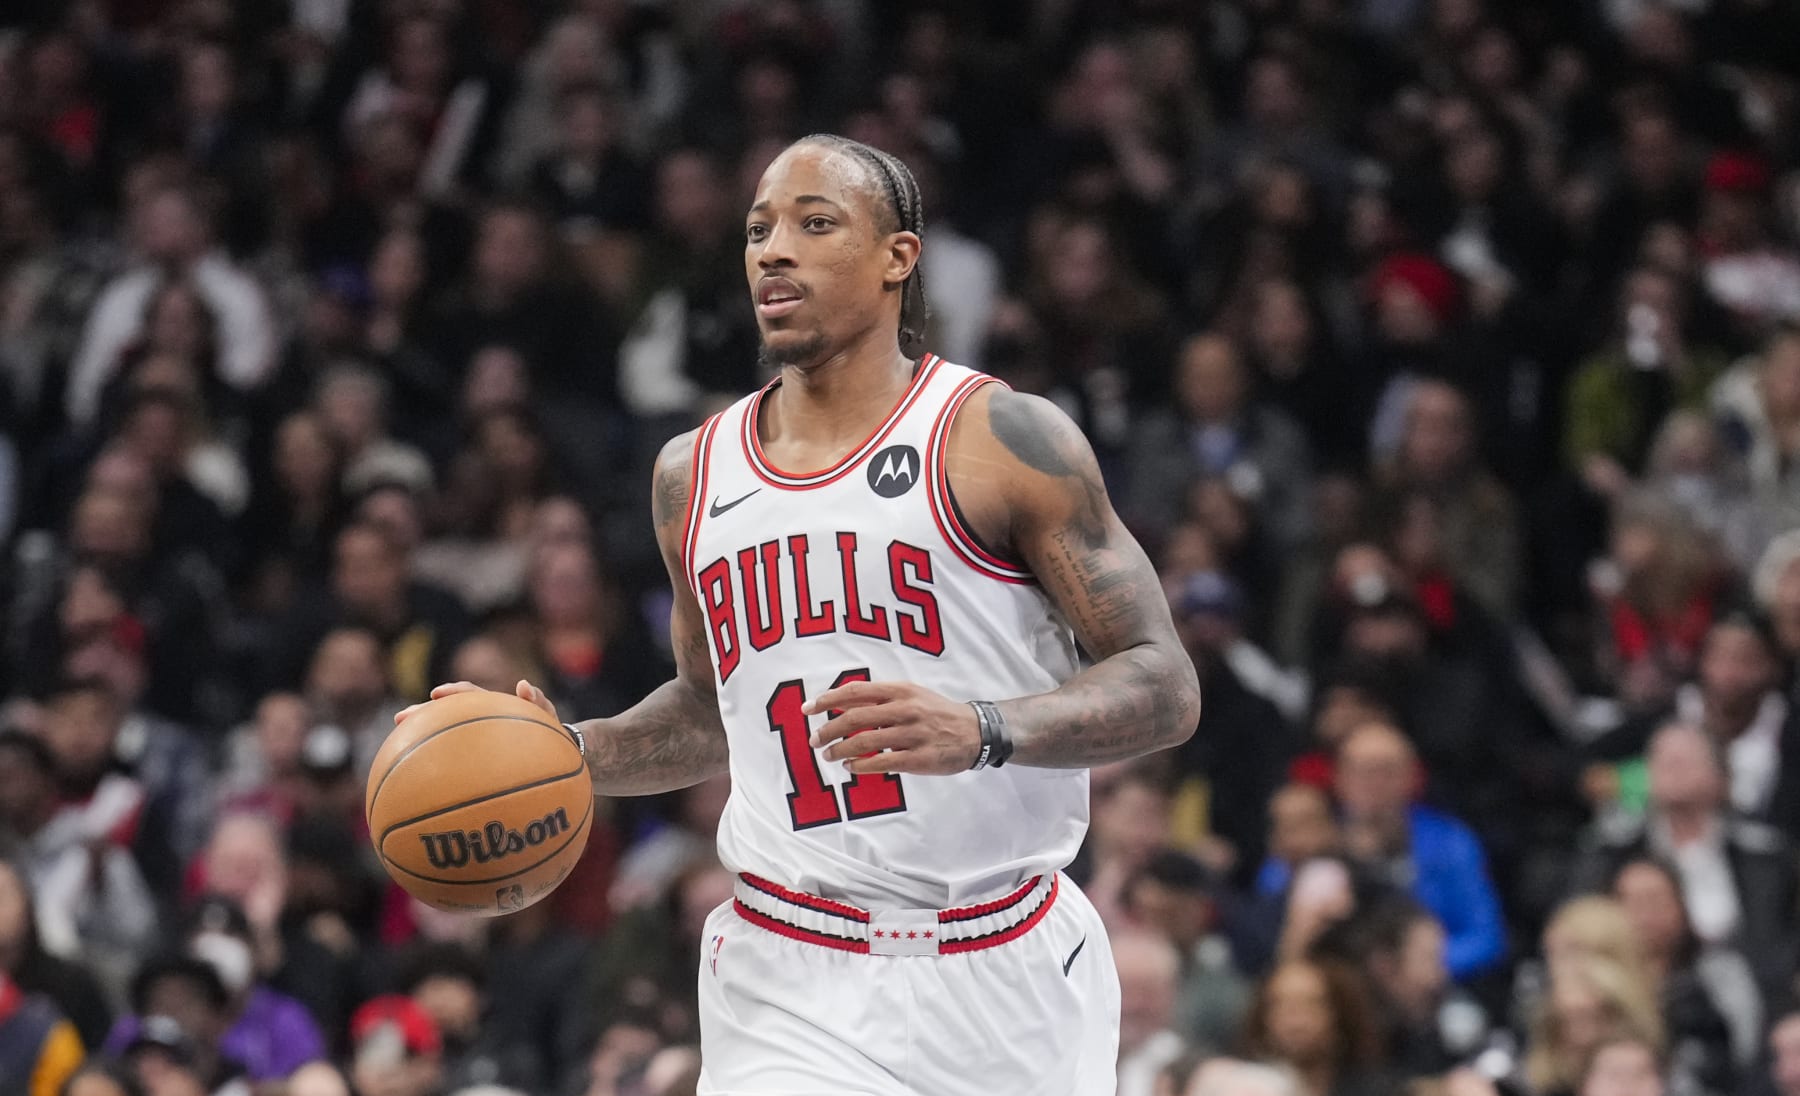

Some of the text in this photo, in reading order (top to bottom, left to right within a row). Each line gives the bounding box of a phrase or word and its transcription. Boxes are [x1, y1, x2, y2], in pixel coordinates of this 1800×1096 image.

[698, 531, 945, 686] BULLS
[766, 668, 907, 831] 11
[418, 806, 571, 870] Wilson
